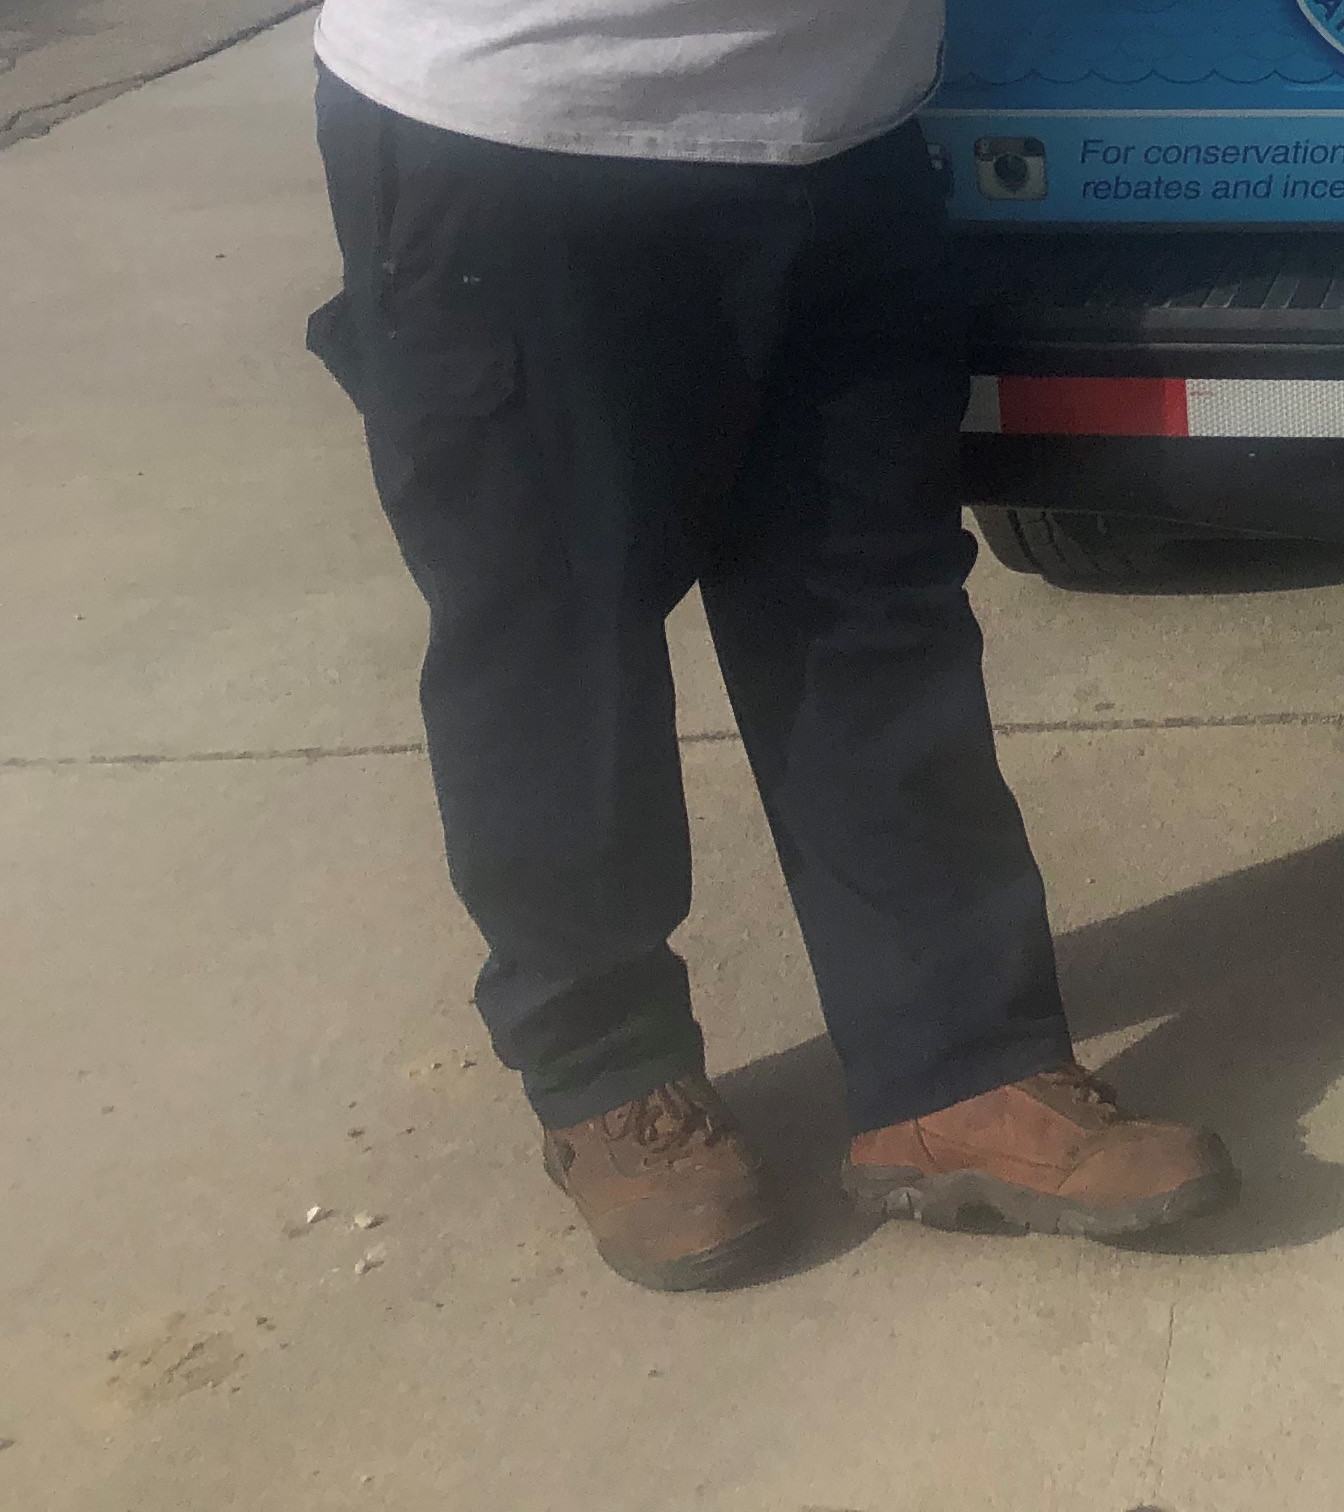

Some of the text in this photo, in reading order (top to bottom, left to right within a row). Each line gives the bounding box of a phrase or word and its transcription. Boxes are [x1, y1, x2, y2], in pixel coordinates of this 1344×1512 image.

[1080, 139, 1135, 165] For
[1081, 173, 1202, 200] rebates
[1211, 174, 1272, 200] and
